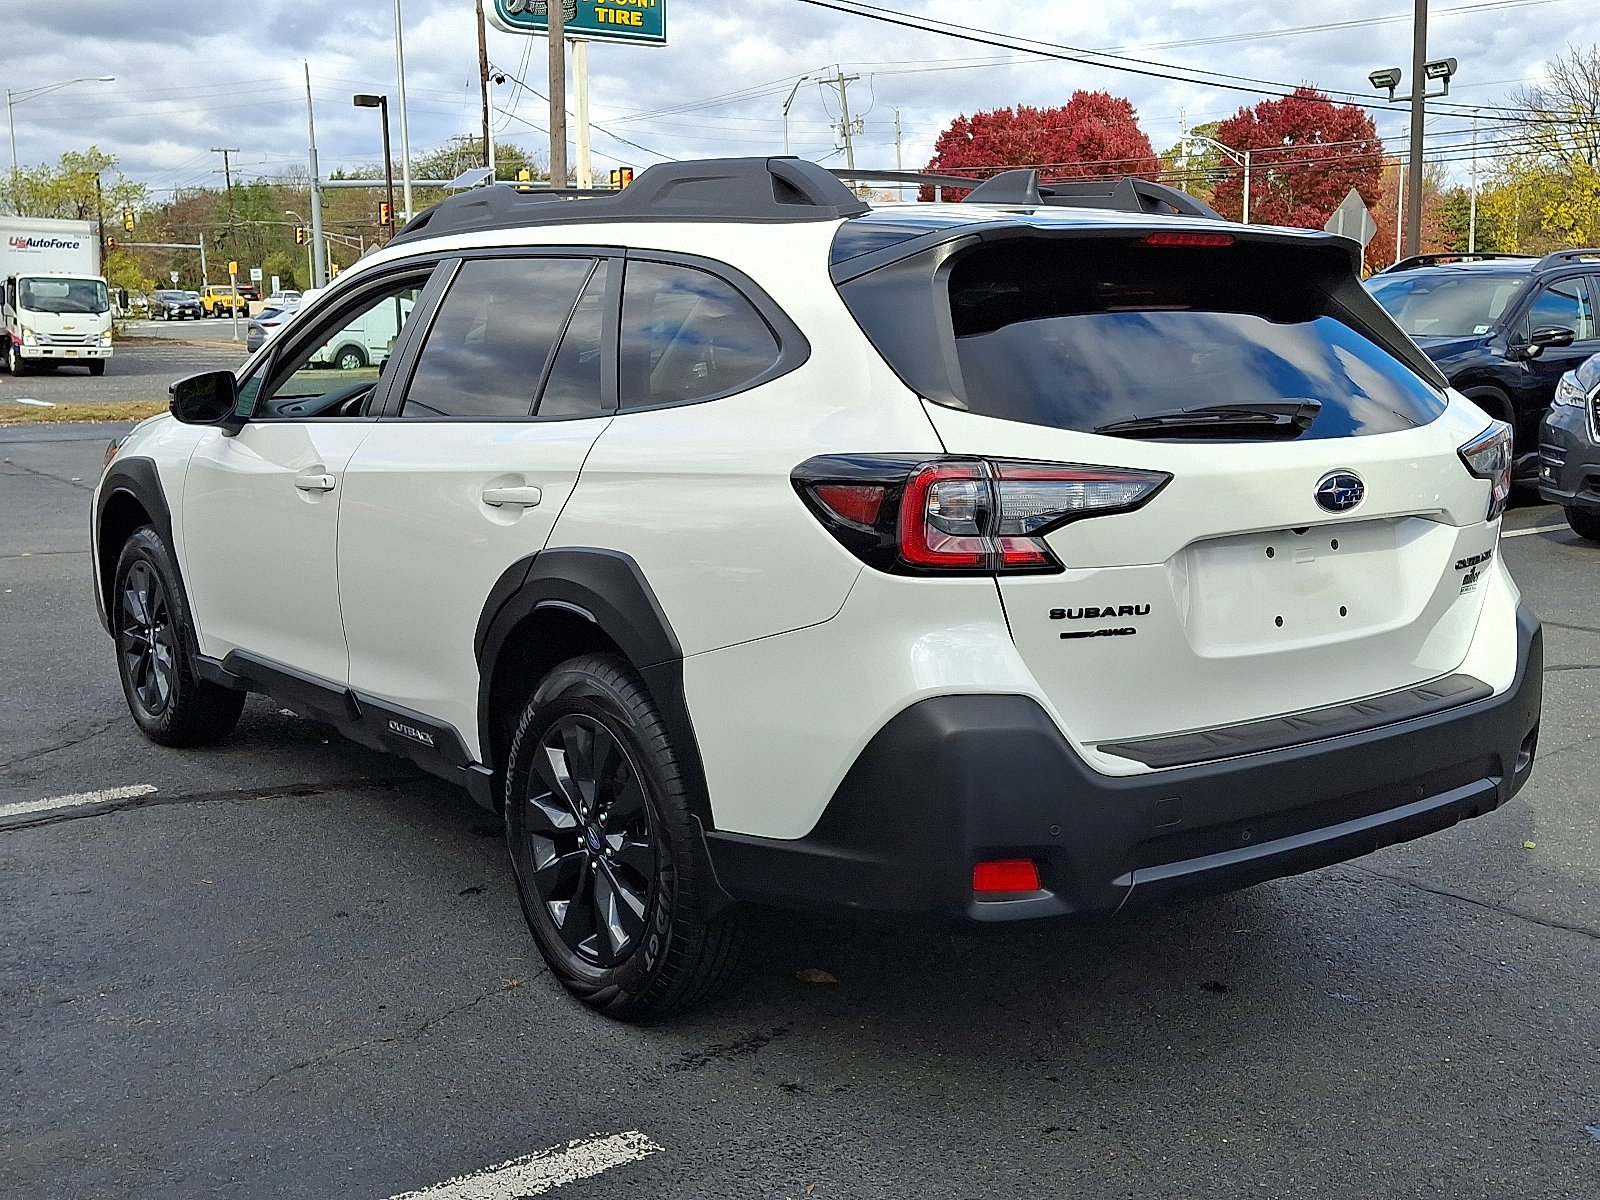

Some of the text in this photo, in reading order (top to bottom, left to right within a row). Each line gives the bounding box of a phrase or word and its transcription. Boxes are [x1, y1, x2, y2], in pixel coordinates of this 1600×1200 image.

[594, 7, 643, 26] TIRE
[1049, 604, 1151, 620] SUBARU
[1090, 627, 1137, 637] AWD
[388, 720, 434, 745] OUTBACK
